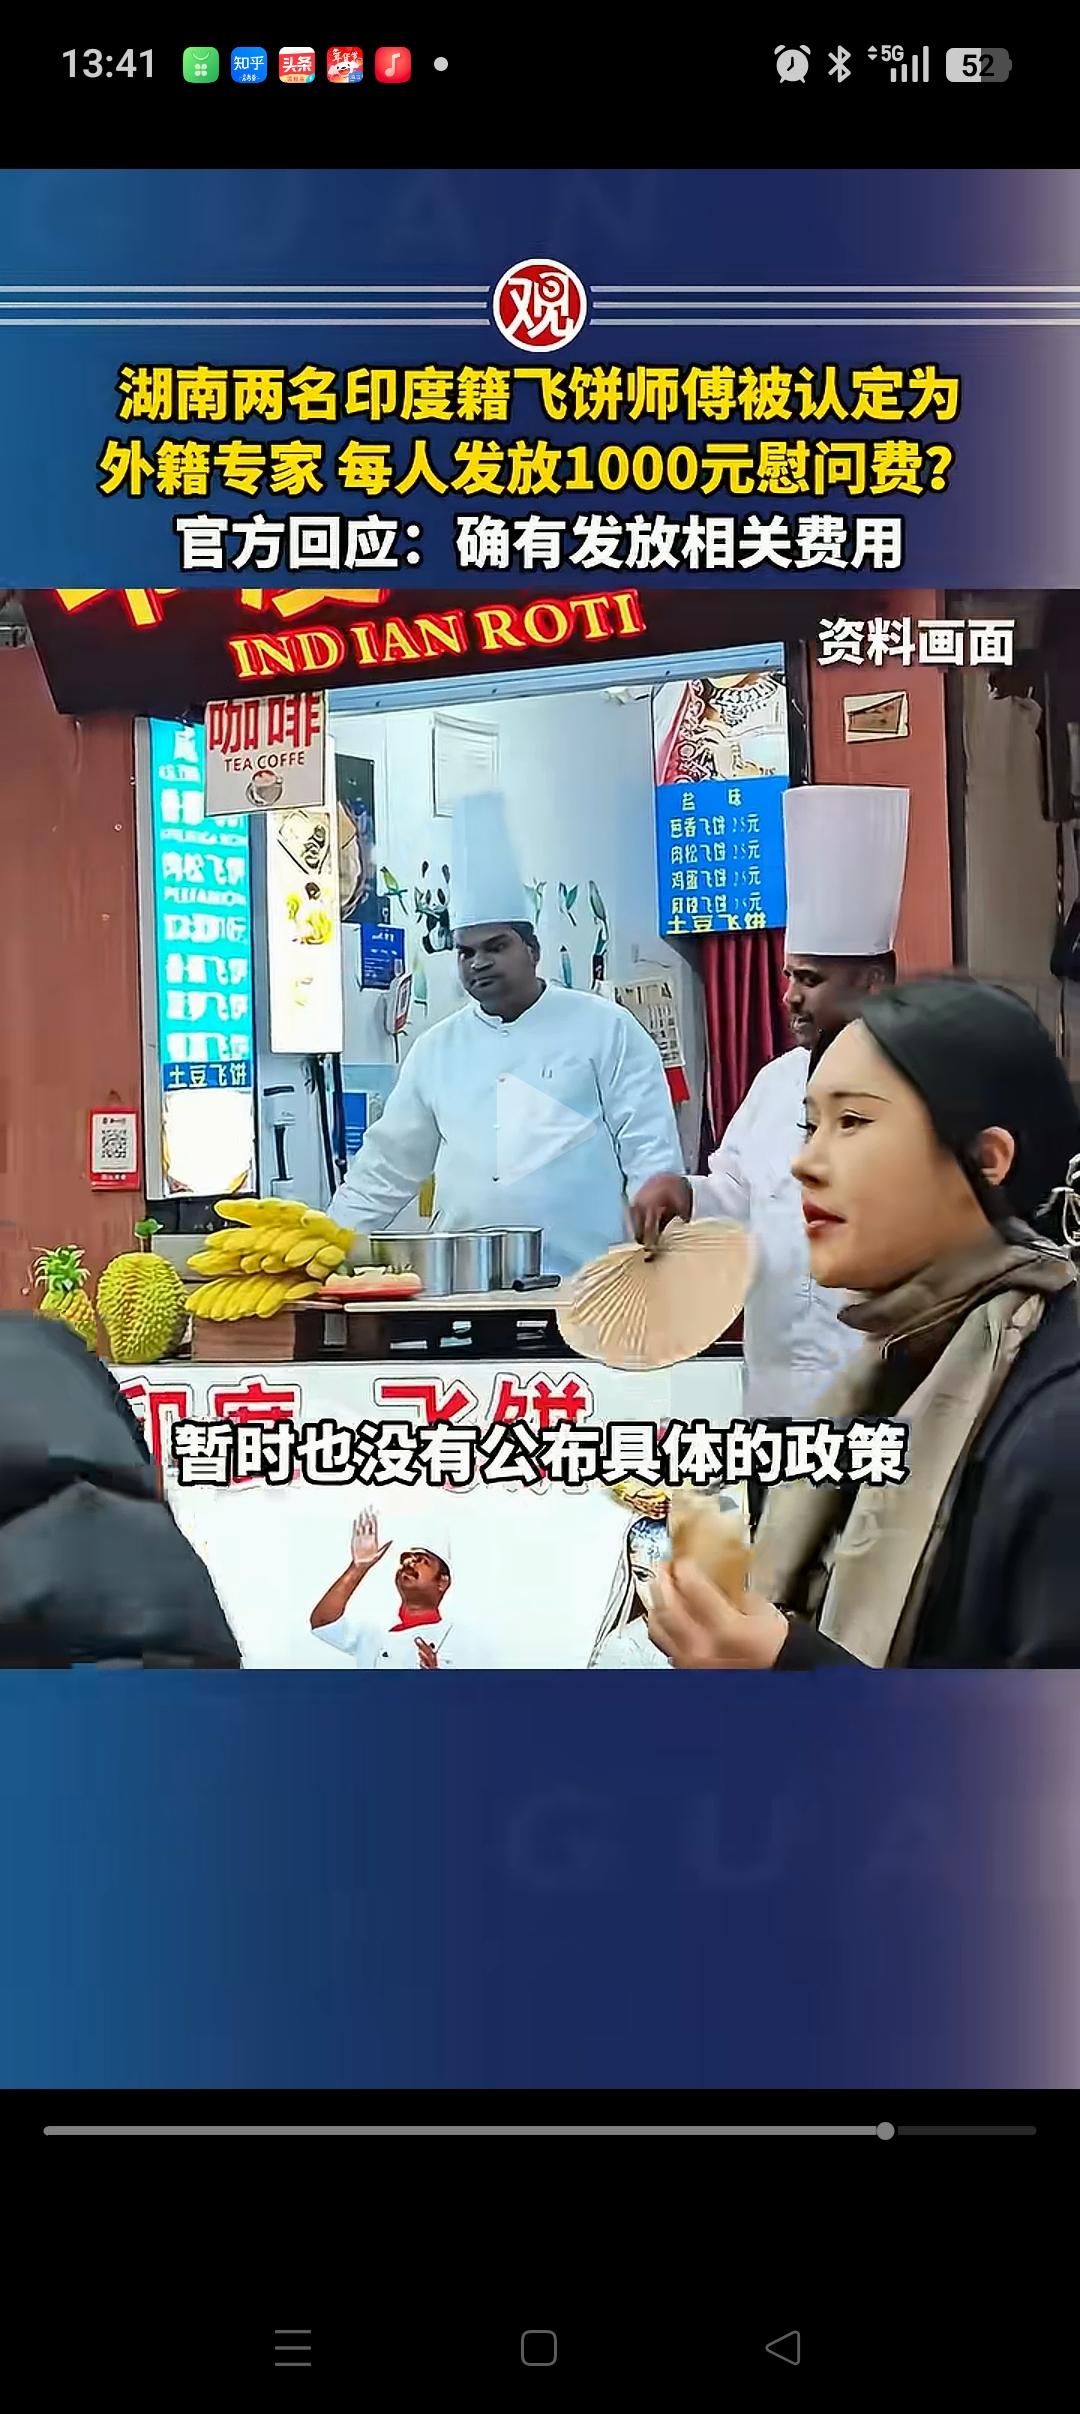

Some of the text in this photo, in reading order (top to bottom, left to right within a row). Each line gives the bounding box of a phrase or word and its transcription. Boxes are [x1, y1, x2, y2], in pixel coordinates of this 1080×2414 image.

[62, 48, 154, 79] 13:41
[233, 55, 265, 71] 知乎
[282, 56, 313, 73] 头条
[881, 45, 904, 61] 5G
[961, 54, 996, 78] 52
[475, 591, 646, 651] ROTI
[207, 692, 322, 755] 咖啡
[224, 751, 305, 772] TEA COFFE
[666, 911, 767, 934] 土豆飞饼
[168, 1062, 247, 1088] 土豆飞饼
